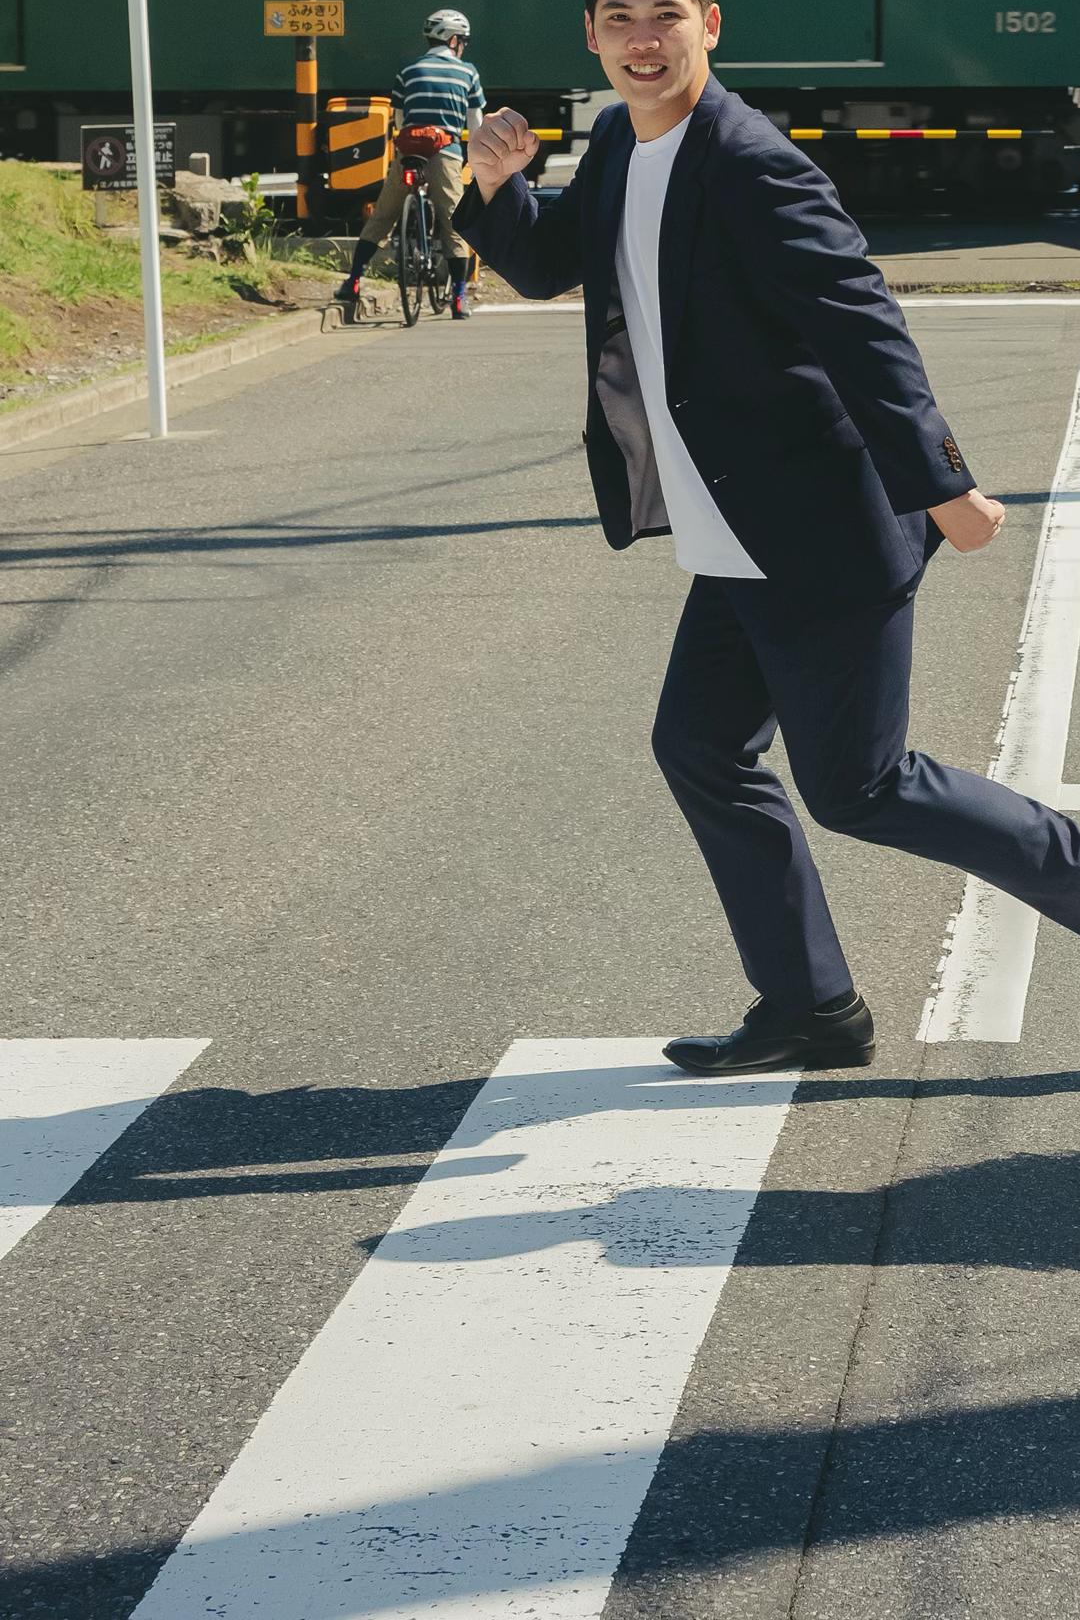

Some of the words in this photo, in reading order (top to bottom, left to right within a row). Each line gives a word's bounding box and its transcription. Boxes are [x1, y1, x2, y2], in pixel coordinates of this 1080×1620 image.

[288, 4, 339, 17] ふみきり
[288, 20, 340, 32] ちゅうい
[995, 11, 1057, 33] 1502
[352, 147, 360, 159] 2
